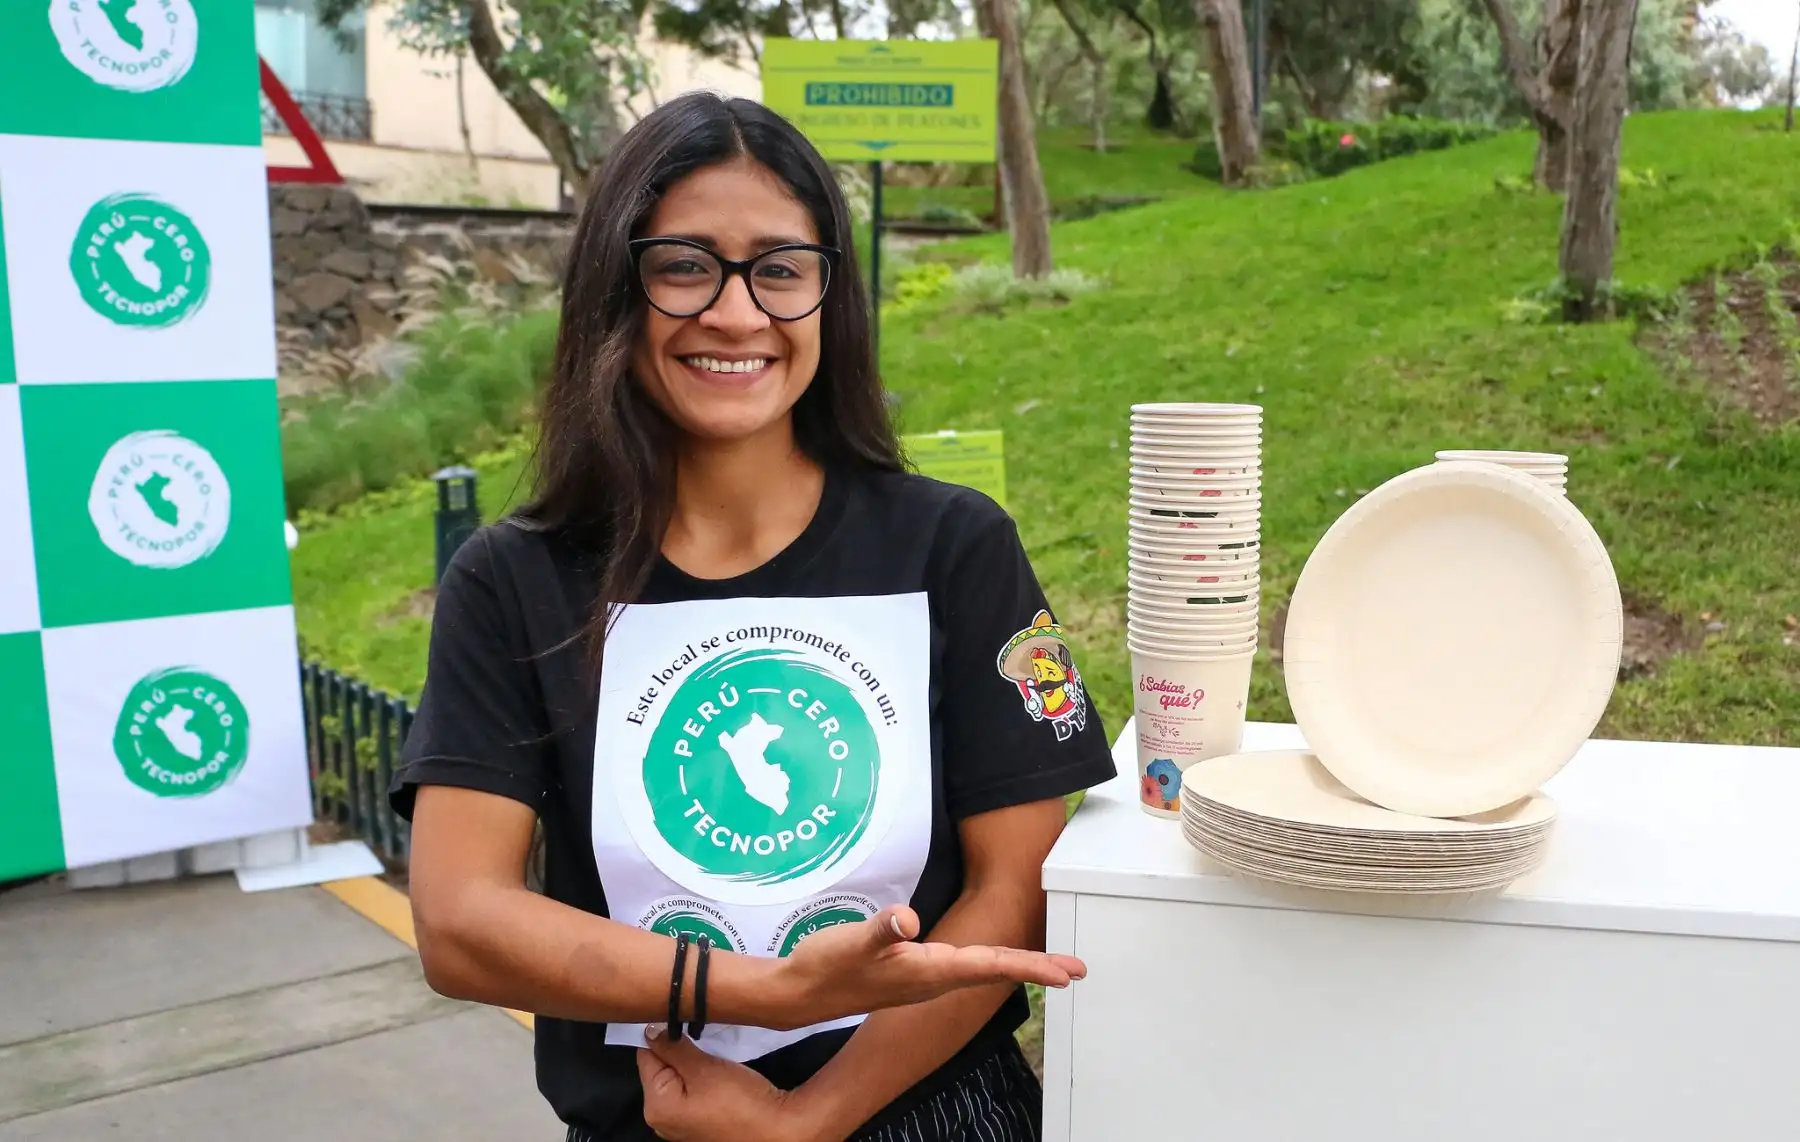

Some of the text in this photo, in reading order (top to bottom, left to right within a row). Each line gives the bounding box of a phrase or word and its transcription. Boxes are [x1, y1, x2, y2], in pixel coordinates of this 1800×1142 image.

[80, 37, 173, 75] TECNOPOR
[809, 84, 949, 105] PROHIBIDO
[86, 211, 195, 262] PERÚ CERO
[97, 281, 190, 316] TECNOPOR
[108, 452, 211, 498] PERÚ CERO
[119, 521, 206, 552] TECNOPOR
[626, 624, 899, 727] Este local se compromete con un:
[1139, 673, 1186, 694] ¿Sabías
[128, 686, 233, 736] PERÚ CERO
[1159, 688, 1205, 711] qué?
[674, 682, 849, 761] PERÚ CERO
[141, 750, 230, 785] TECNOPOR
[683, 799, 837, 856] TECNOPOR
[640, 905, 658, 926] local
[657, 902, 667, 911] se
[667, 899, 724, 922] compromete
[723, 921, 739, 938] con
[767, 894, 879, 953] Este local se compromete con
